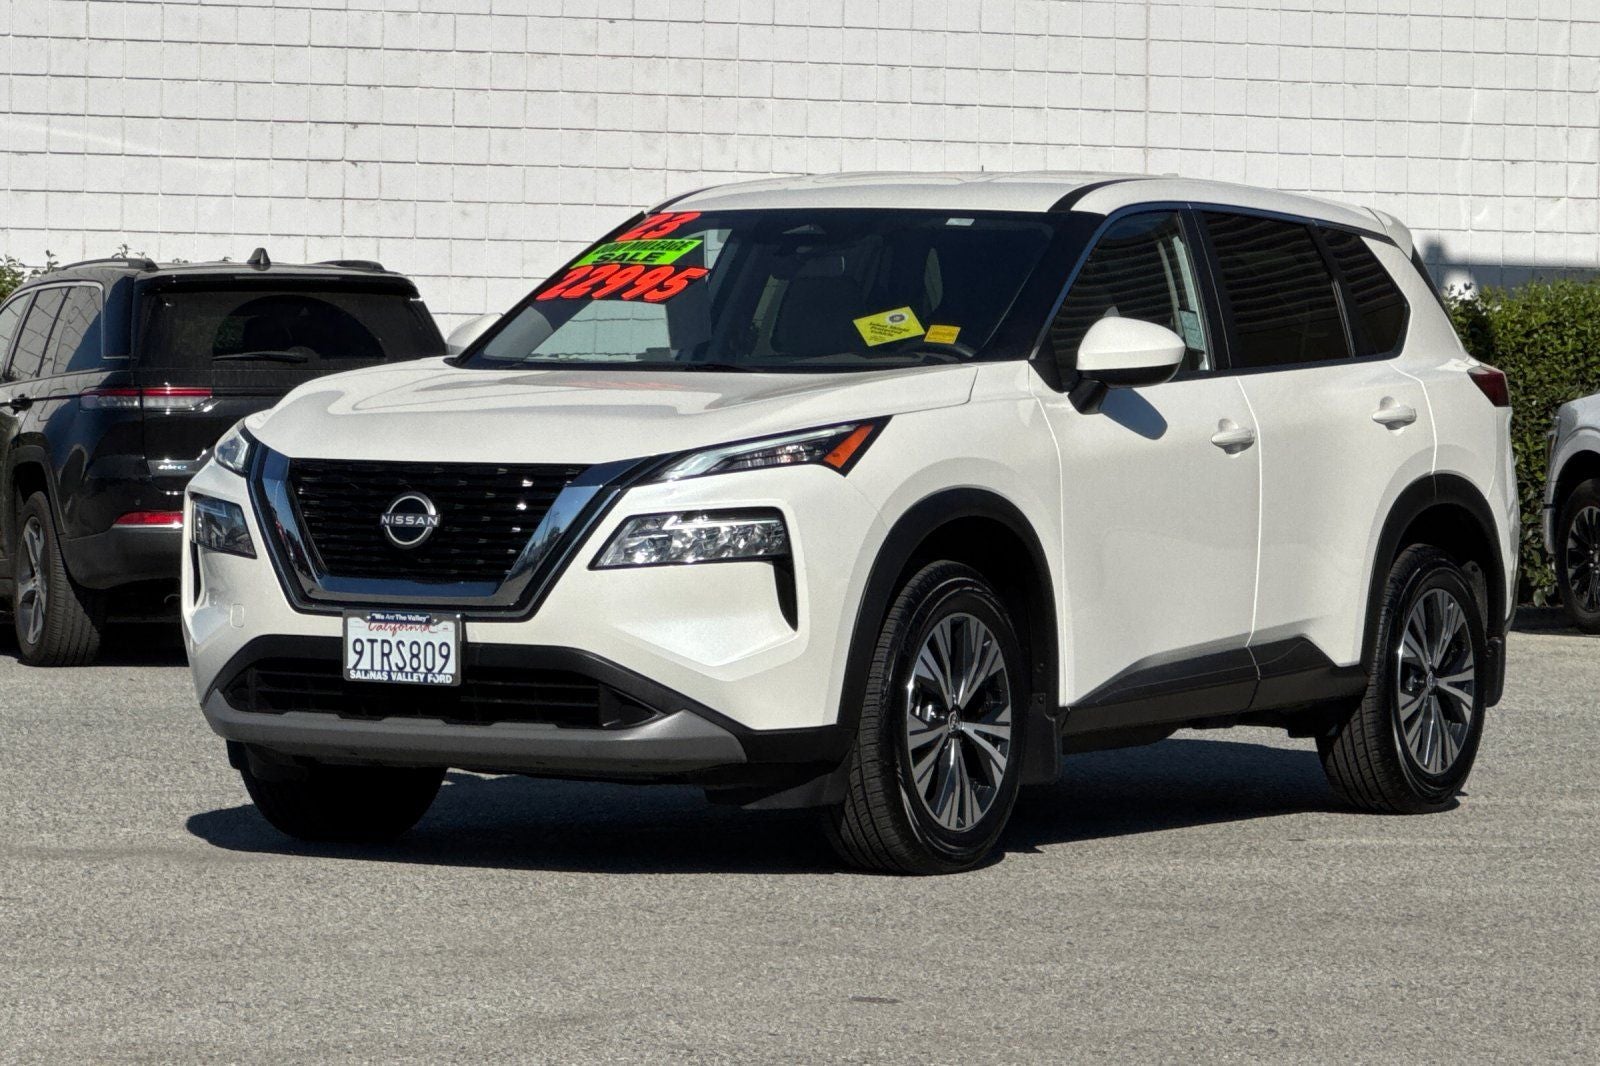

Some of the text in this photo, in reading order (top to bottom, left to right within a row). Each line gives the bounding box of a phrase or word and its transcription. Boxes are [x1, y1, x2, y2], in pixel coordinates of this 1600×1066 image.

[615, 211, 701, 241] 23
[592, 251, 667, 263] SALE
[536, 263, 709, 302] 22995
[381, 514, 439, 526] NISSAN
[396, 613, 407, 621] The
[368, 622, 437, 637] California
[352, 638, 451, 673] 9TRS809
[350, 669, 453, 684] SALINAS VALLEY FORD
